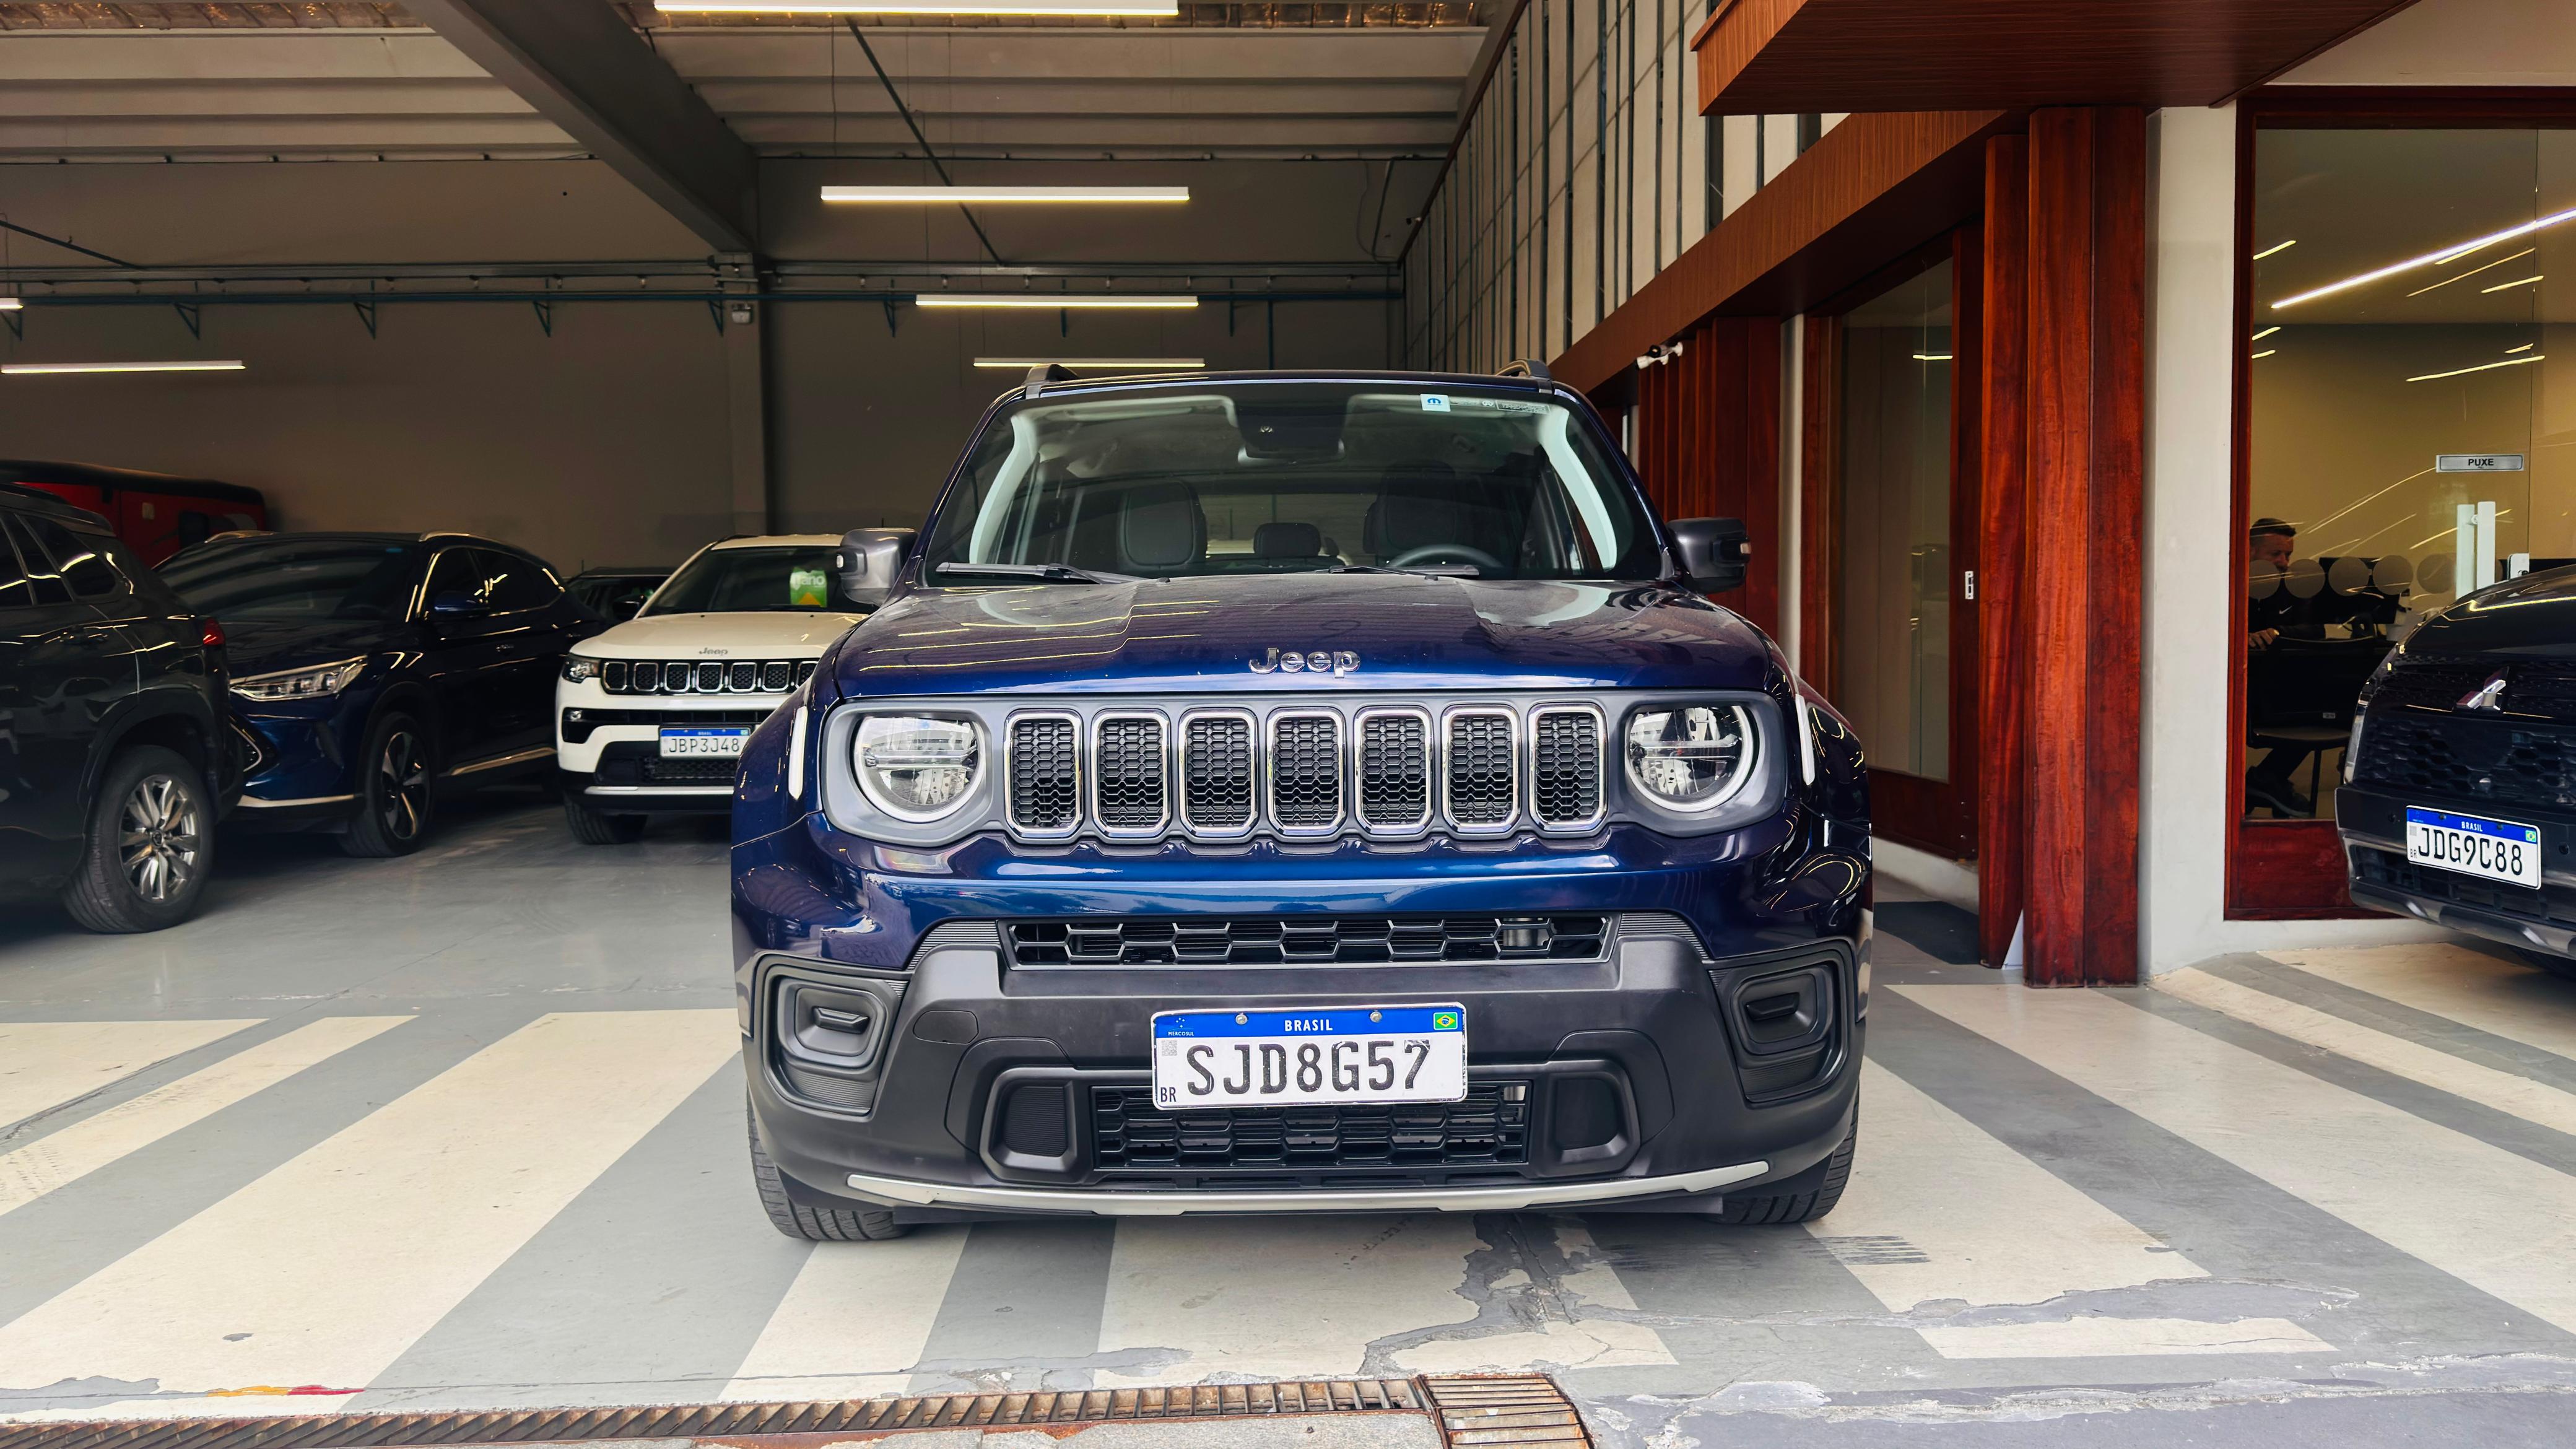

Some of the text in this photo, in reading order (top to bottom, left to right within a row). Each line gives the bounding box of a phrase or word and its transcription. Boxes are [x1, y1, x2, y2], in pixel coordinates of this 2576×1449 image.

[2468, 458, 2494, 466] PUXE
[698, 646, 729, 656] Jeep
[1248, 647, 1360, 678] Jeep
[669, 738, 740, 753] JBP3J48
[2461, 821, 2483, 832] BRASIL
[2418, 827, 2523, 876] JDG9C88
[1284, 1019, 1333, 1032] BRASIL
[1186, 1040, 1431, 1095] SJD8G57
[1160, 1087, 1177, 1103] BR
